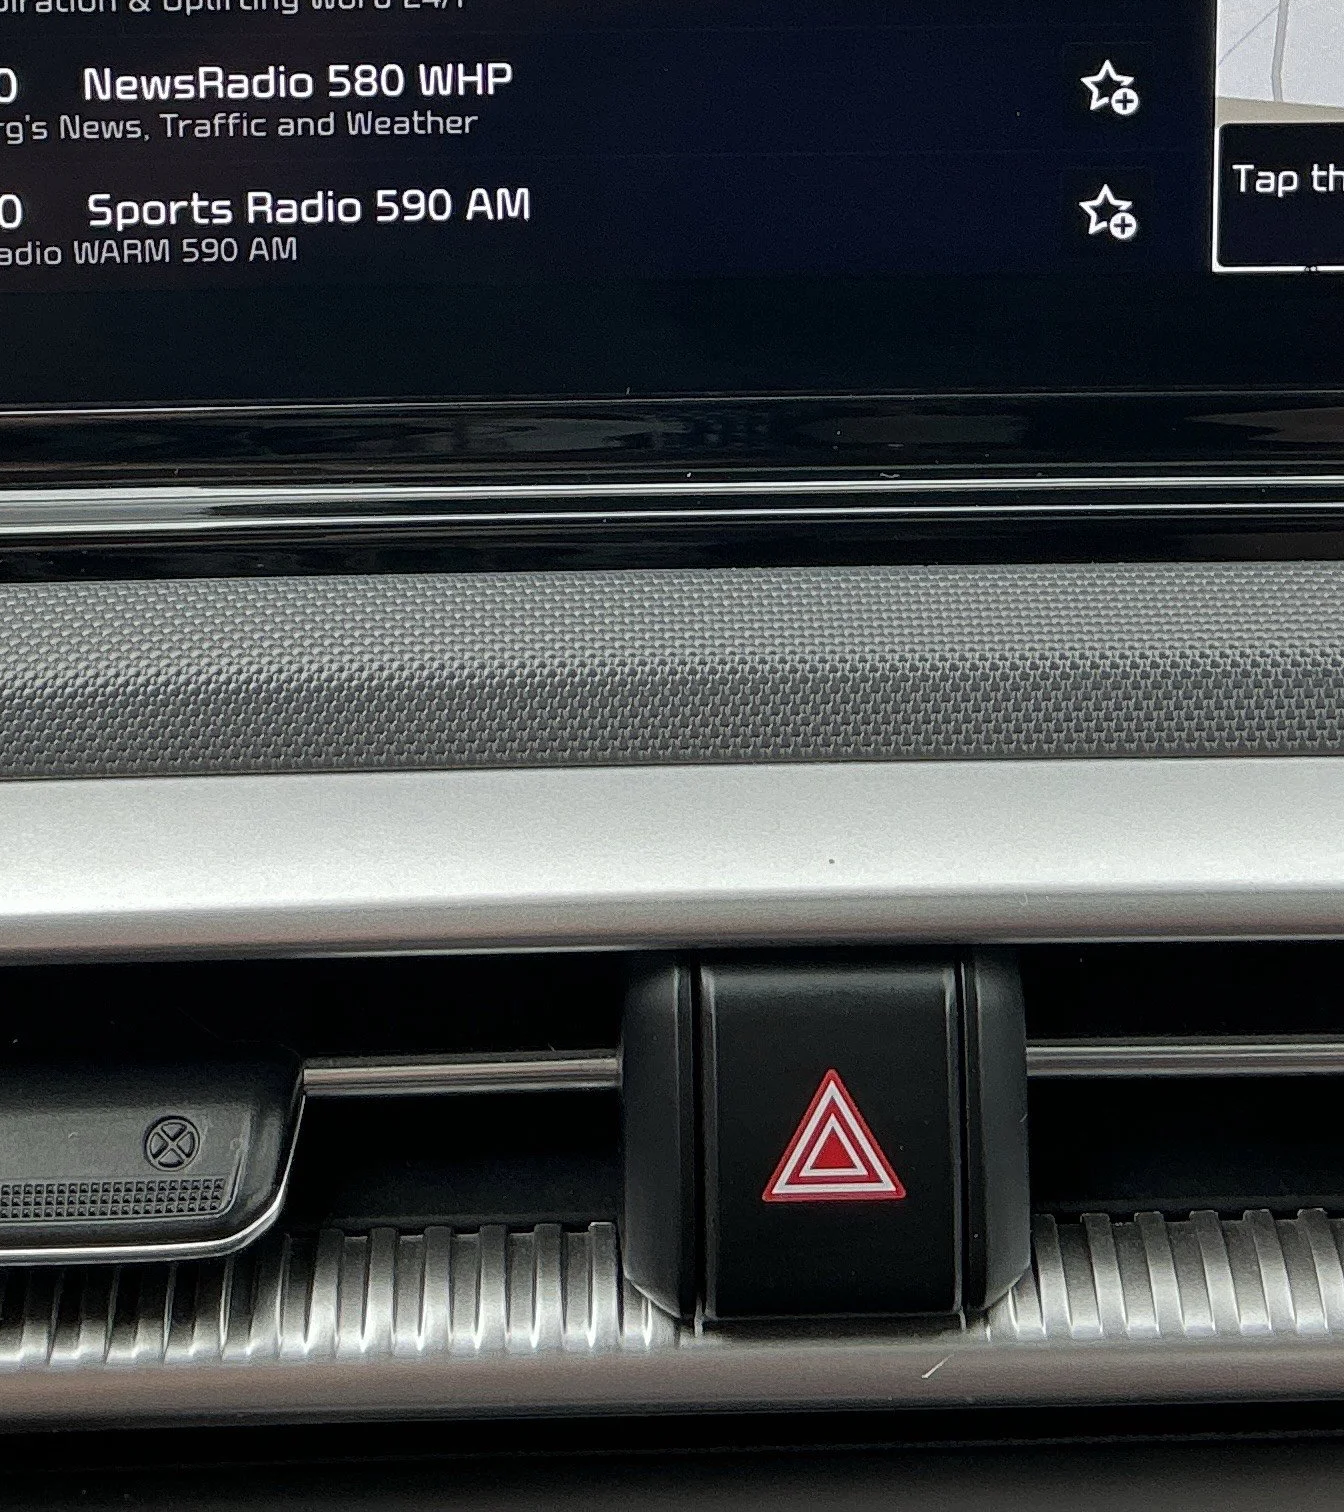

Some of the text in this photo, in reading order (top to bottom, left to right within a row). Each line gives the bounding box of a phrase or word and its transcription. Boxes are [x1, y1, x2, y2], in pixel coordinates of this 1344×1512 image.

[84, 66, 313, 100] NewsRadio
[329, 64, 404, 97] 580
[419, 63, 512, 96] WHP
[60, 115, 149, 140] News,
[159, 113, 266, 137] Traffic
[278, 112, 334, 136] and
[347, 110, 478, 135] Weather
[1232, 165, 1298, 197] Tap
[88, 193, 232, 231] Sports
[248, 191, 361, 223] Radio
[377, 189, 452, 221] 590
[466, 188, 529, 220] AM
[74, 239, 169, 264] WARM
[183, 238, 238, 262] 590
[249, 237, 297, 261] AM
